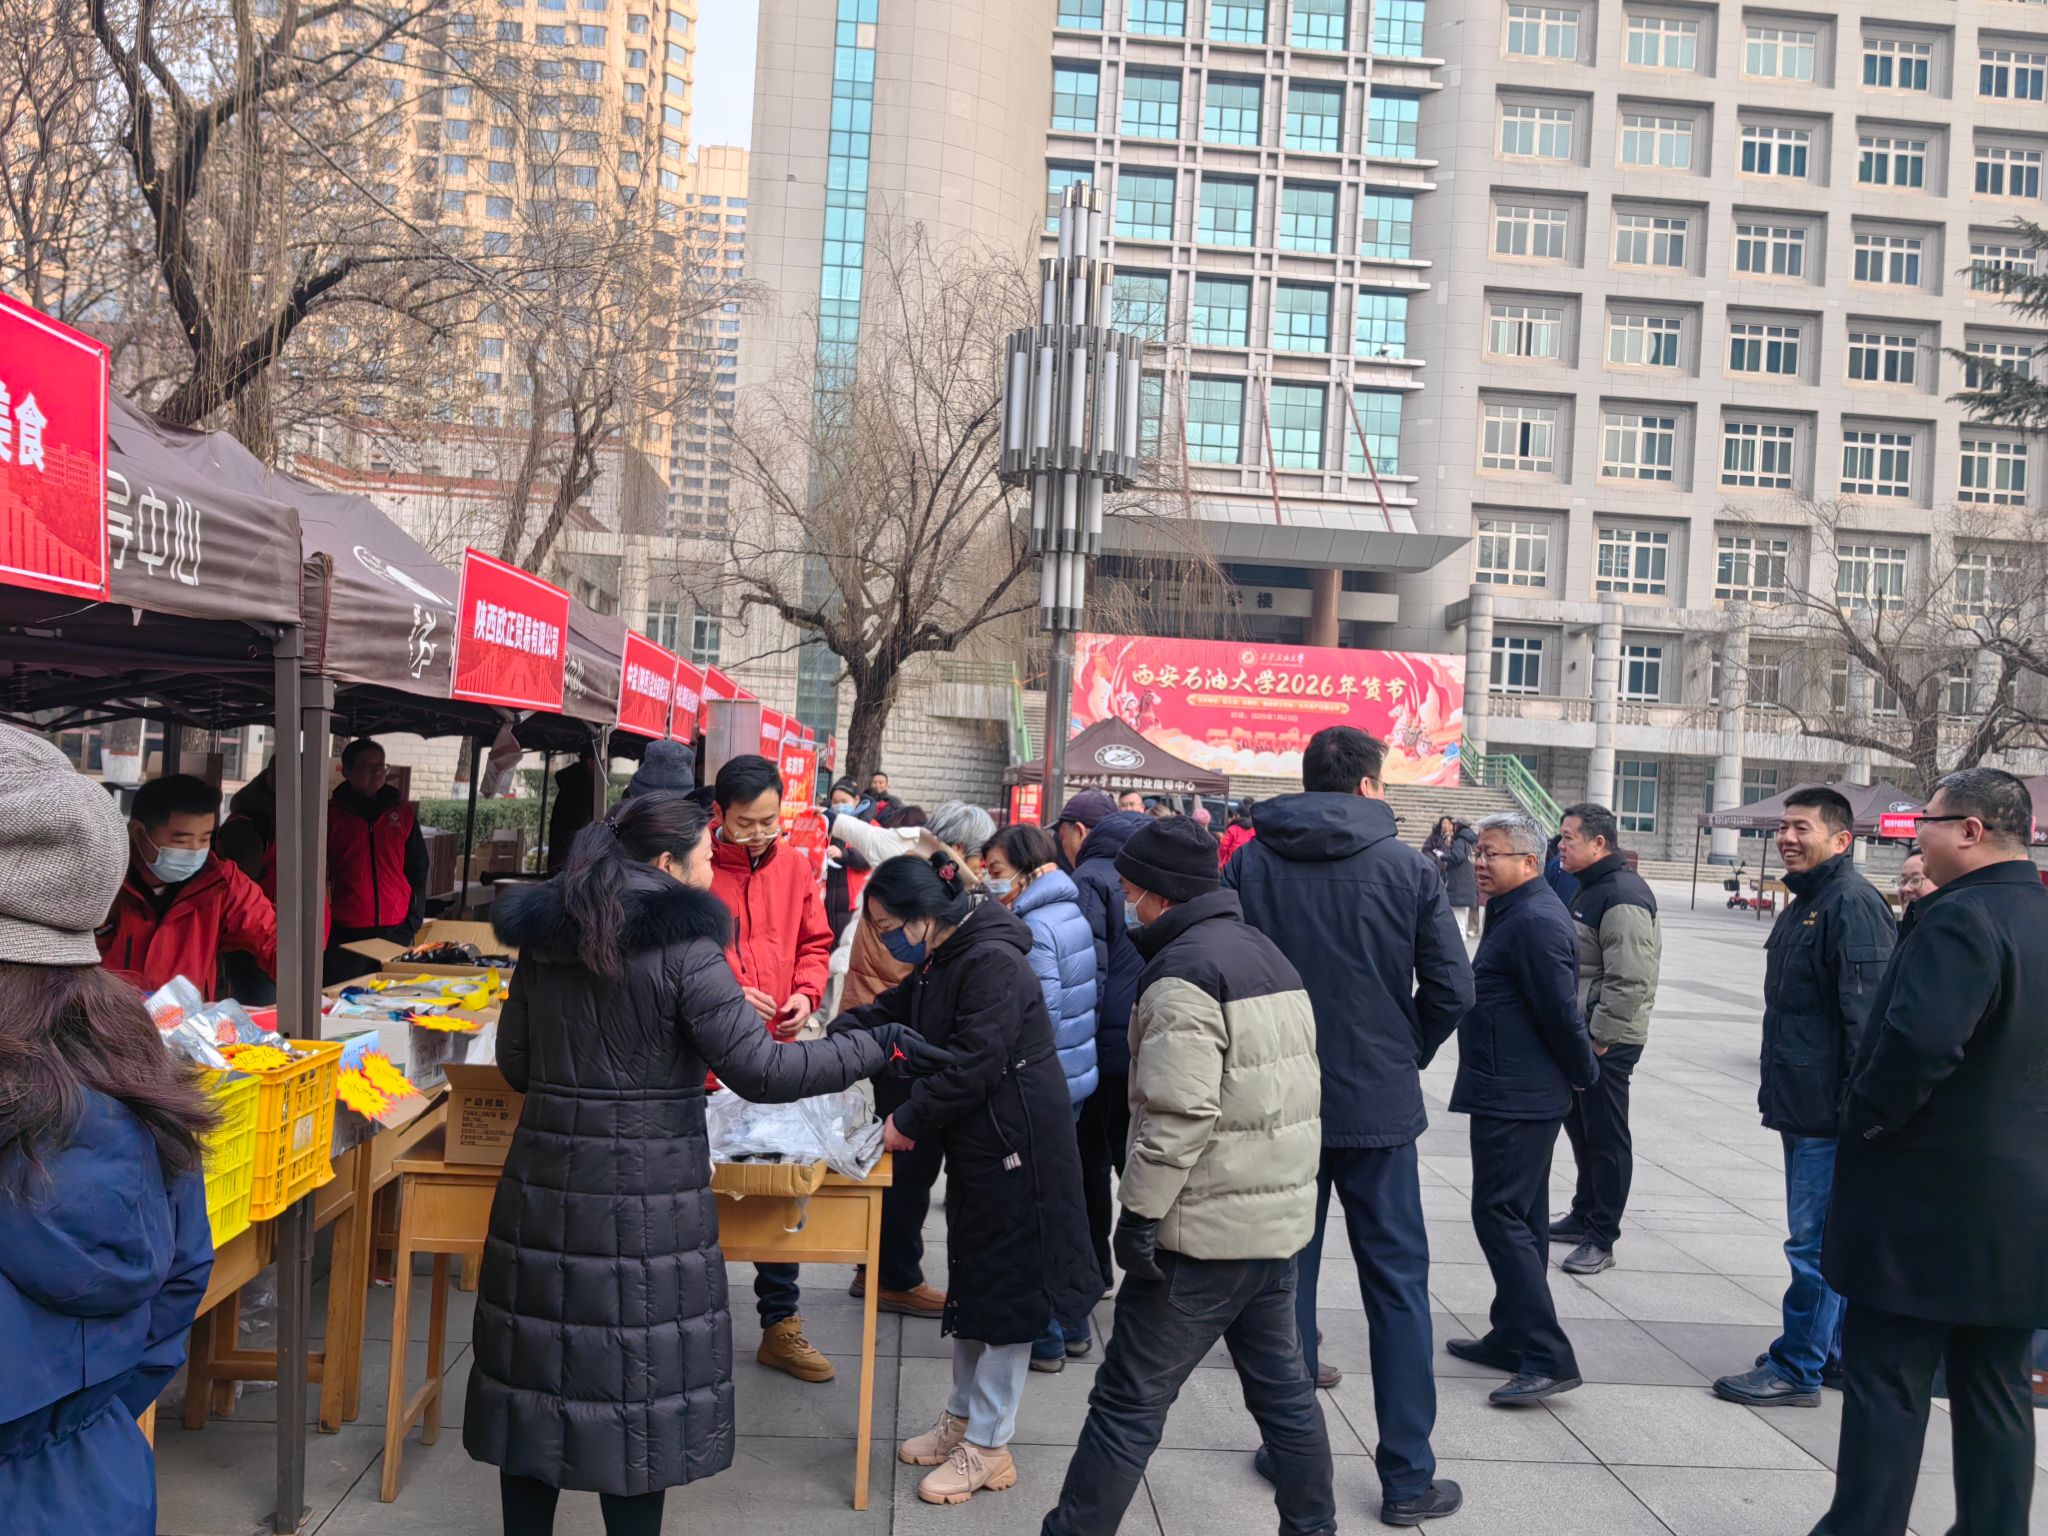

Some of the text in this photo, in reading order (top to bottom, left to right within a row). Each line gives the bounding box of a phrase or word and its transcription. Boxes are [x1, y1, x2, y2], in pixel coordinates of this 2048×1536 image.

[474, 599, 560, 661] 陕西欧正贸易有限公司
[1132, 663, 1407, 705] 西安石油大学2026年货节
